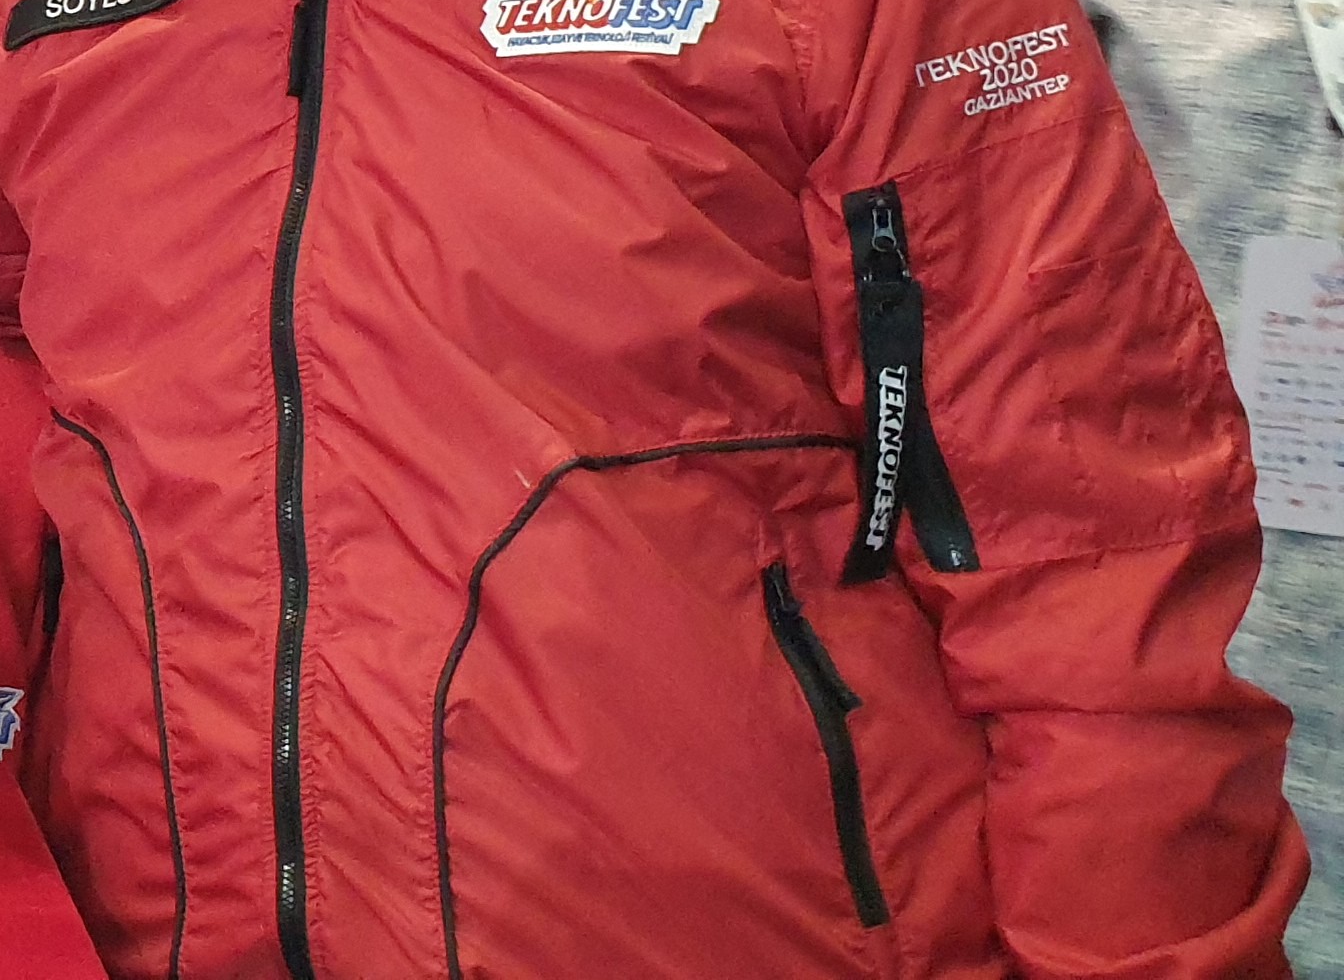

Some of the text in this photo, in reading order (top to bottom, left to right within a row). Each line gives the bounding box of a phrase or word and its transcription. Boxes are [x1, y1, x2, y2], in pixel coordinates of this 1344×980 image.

[915, 23, 1070, 87] TEKNOFEST
[979, 57, 1038, 91] 2020
[865, 364, 907, 552] TEKNOFEST
